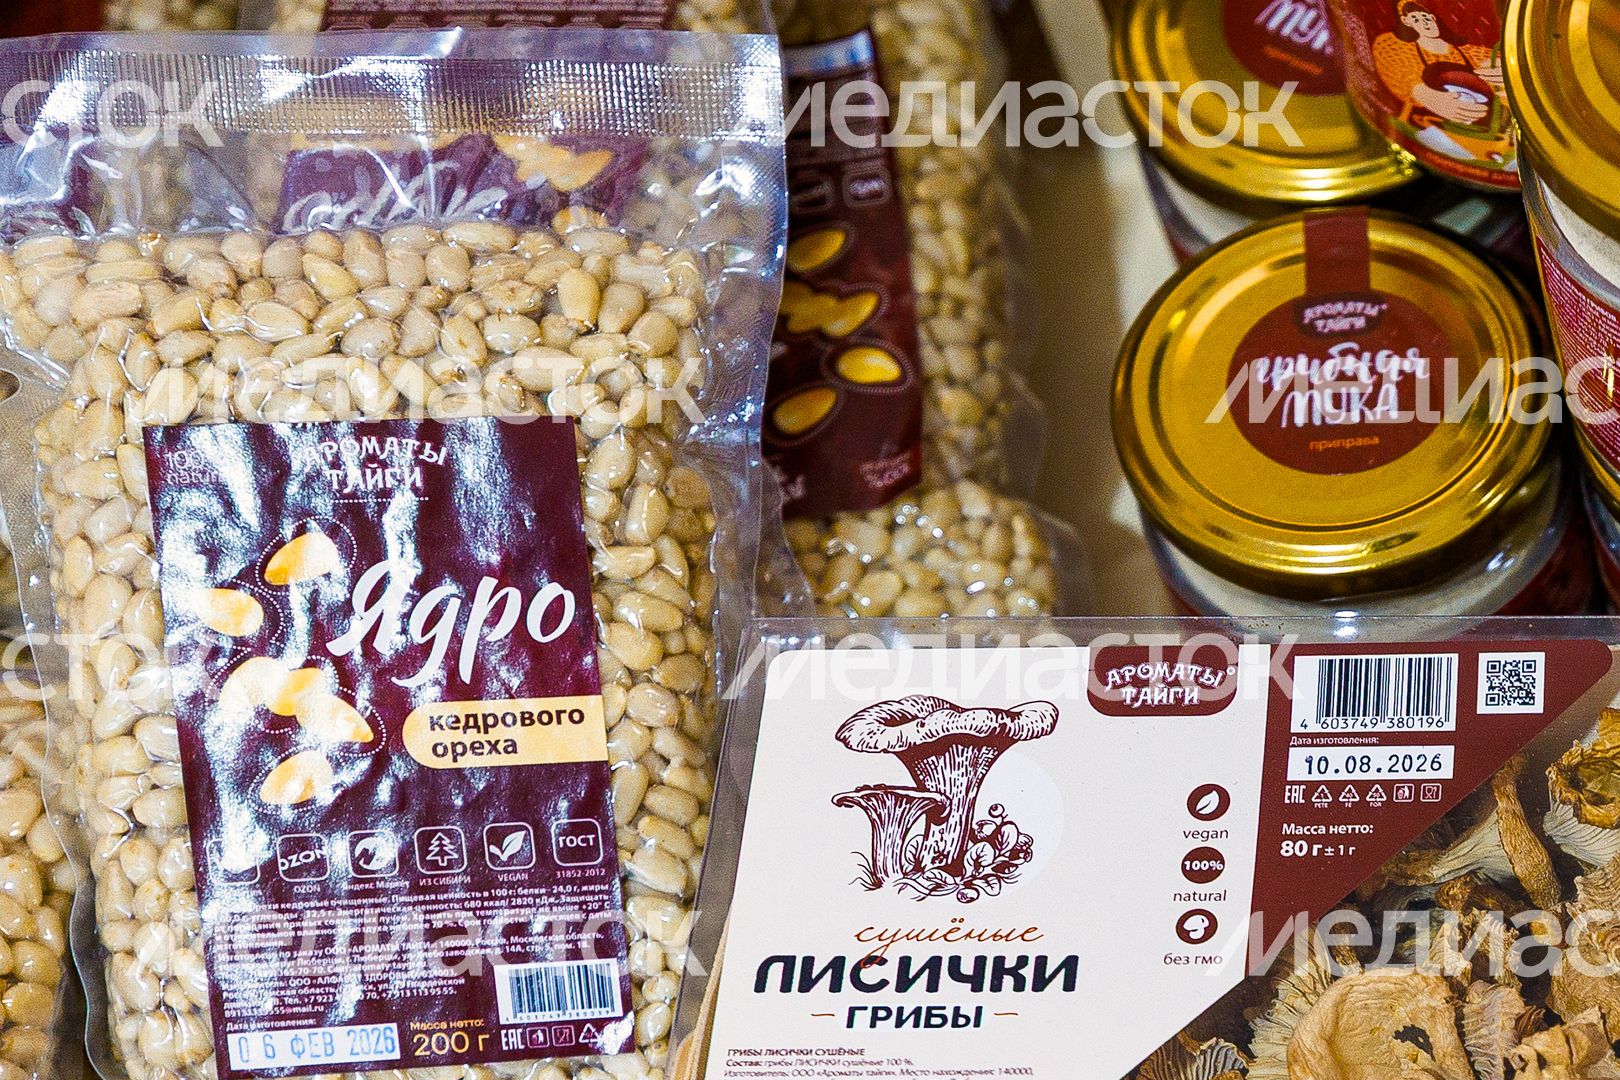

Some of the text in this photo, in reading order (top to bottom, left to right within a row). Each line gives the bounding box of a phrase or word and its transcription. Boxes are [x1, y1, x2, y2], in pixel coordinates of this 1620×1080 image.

[1256, 341, 1430, 391] грибная
[1309, 436, 1380, 451] приправа
[304, 436, 447, 470] АРОМАТЫ
[324, 462, 422, 492] ТАЙГИ
[326, 561, 576, 687] Ядро
[1105, 662, 1225, 691] АРОМАТЫ
[1120, 685, 1201, 709] ТАЙГИ
[429, 707, 585, 733] кедрового
[1300, 716, 1444, 730] 4 603749 380196
[431, 736, 518, 759] ореха
[1290, 735, 1379, 747] Дата изготовления:
[1304, 753, 1443, 776] 10.08.2026
[1284, 784, 1306, 804] EAC
[1183, 828, 1229, 843] vegan
[1282, 823, 1374, 836] Масса нетто:
[559, 835, 595, 848] ГОСТ
[1280, 841, 1356, 858] 80 г 1 г
[1183, 859, 1224, 871] 100%
[419, 876, 471, 886] ИЗ СИБИРИ
[498, 873, 528, 882] VEGAN
[556, 869, 606, 878] 31852-2012
[294, 885, 320, 893] OZON
[491, 889, 506, 897] 100
[553, 884, 572, 894] 24,0
[582, 883, 609, 893] жиры
[1173, 889, 1227, 902] natural
[464, 897, 531, 908] 680 2820
[854, 917, 1045, 969] сушёные
[1163, 953, 1223, 966] без гмо
[753, 954, 1079, 993] ЛИСИЧКИ
[410, 1019, 484, 1030] Масса нетто:
[846, 1005, 983, 1029] ГРИБЫ
[238, 1027, 395, 1063] 0 6 ФЕВ 2026
[413, 1032, 489, 1056] 200 г
[502, 1029, 524, 1050] EAC
[728, 1047, 865, 1057] ГРИБЫ ЛИСИЧКИ СУШЁНЫЕ
